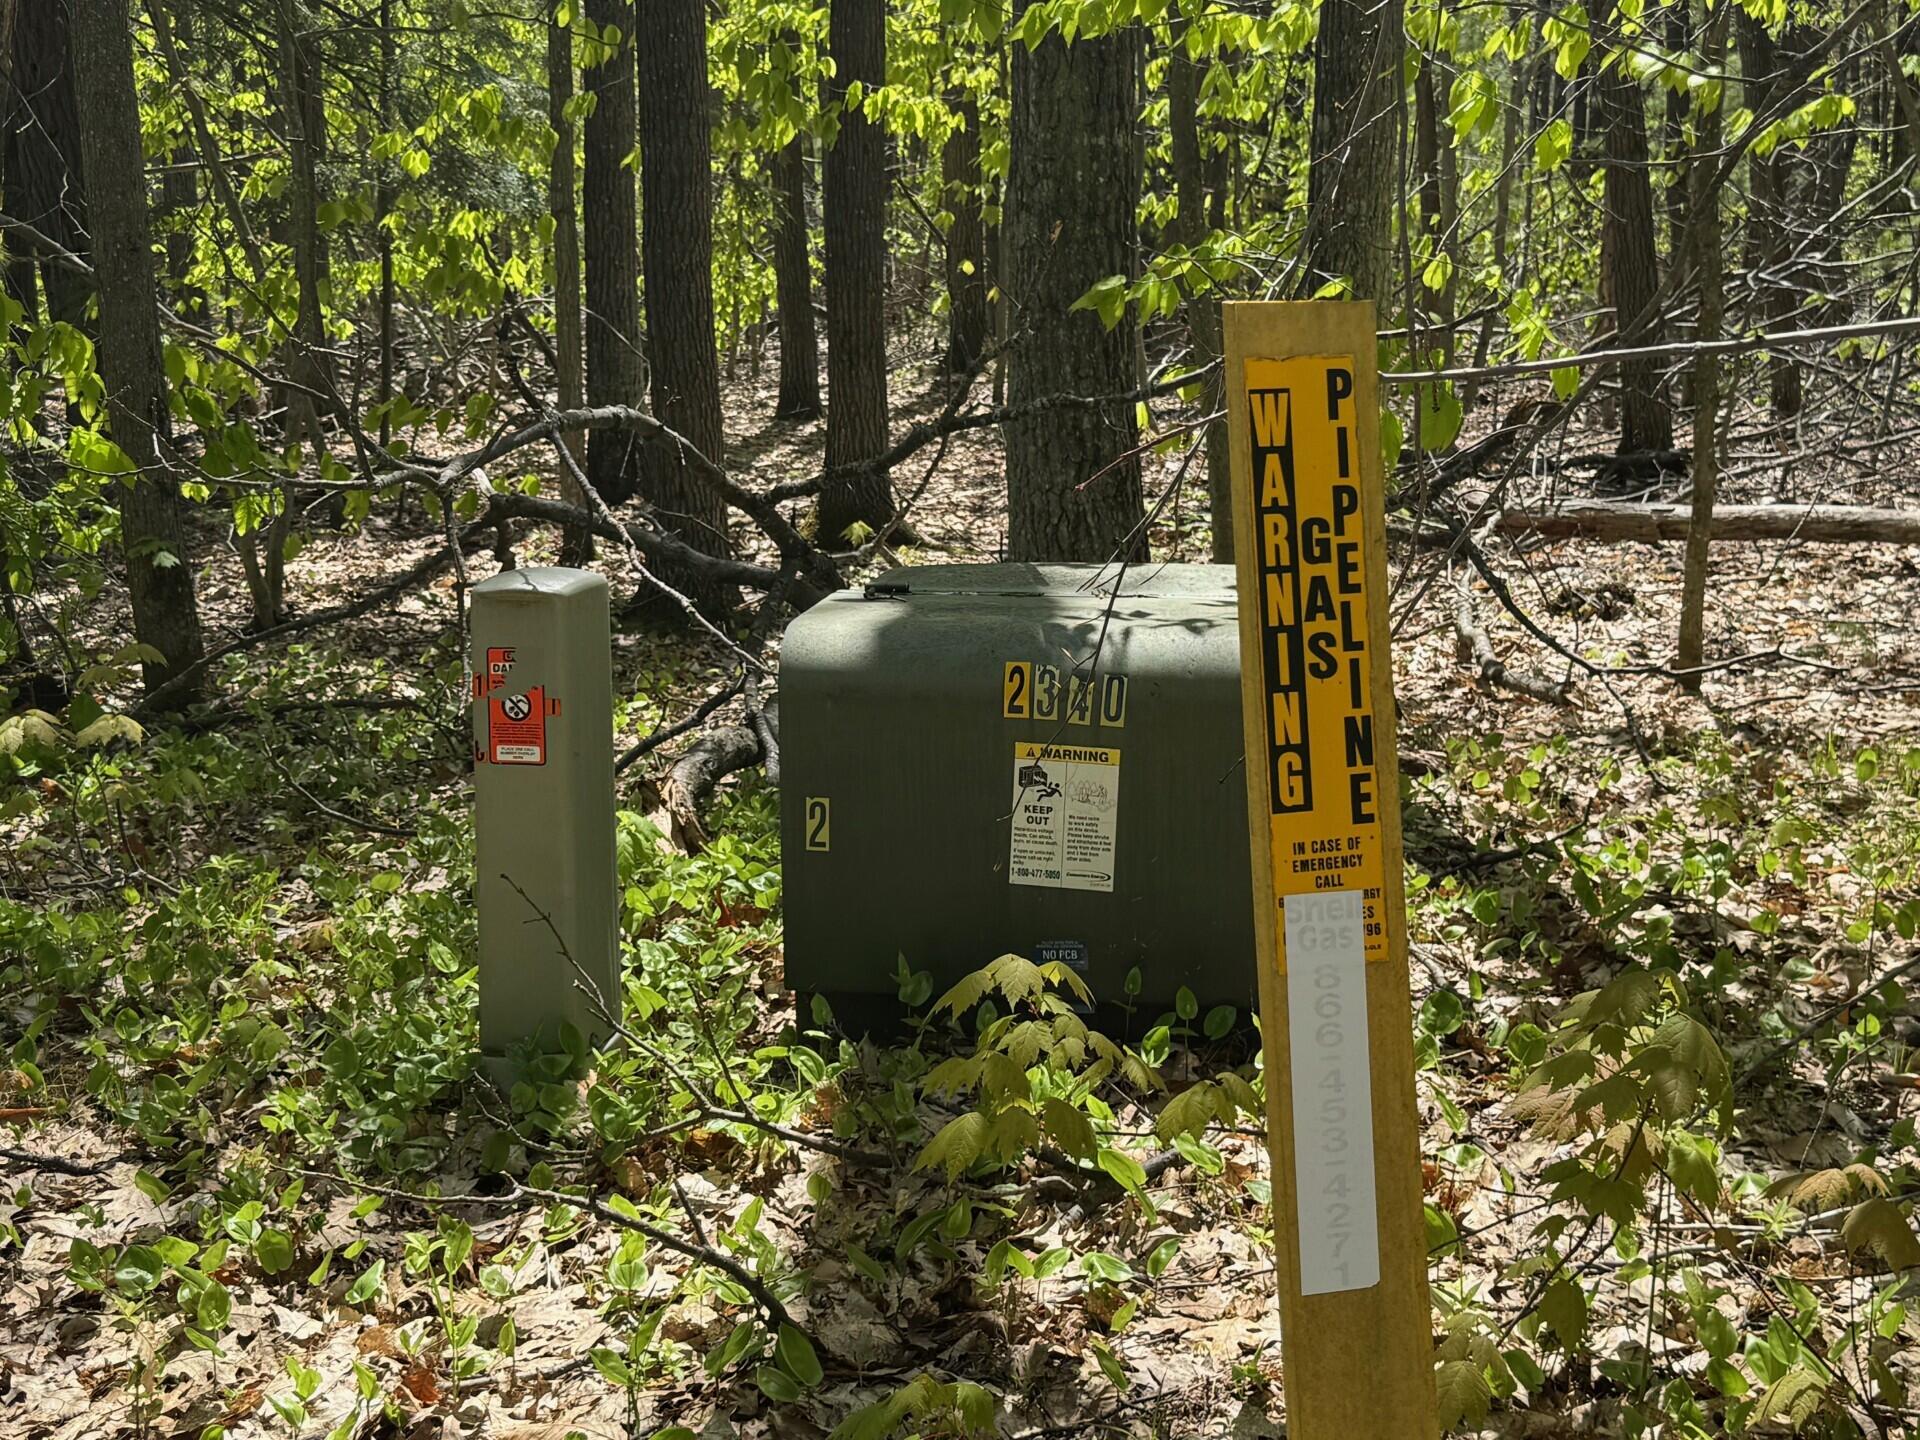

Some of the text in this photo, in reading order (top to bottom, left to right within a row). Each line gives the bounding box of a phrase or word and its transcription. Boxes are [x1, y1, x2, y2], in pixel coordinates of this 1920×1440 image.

[1250, 393, 1305, 807] WARNING
[1301, 517, 1338, 680] GAS
[1326, 368, 1374, 824] PIPELINE
[1008, 665, 1125, 722] 2340
[1040, 747, 1109, 762] WARNING
[1024, 804, 1053, 815] KEEP
[809, 801, 826, 847] 2
[1026, 815, 1050, 826] OUT
[1293, 837, 1361, 855] IN CASE OF
[1293, 854, 1363, 873] EMERGENCY
[1315, 874, 1344, 889] CALL
[1296, 924, 1354, 951] Gas
[1043, 950, 1078, 960] NO PCB
